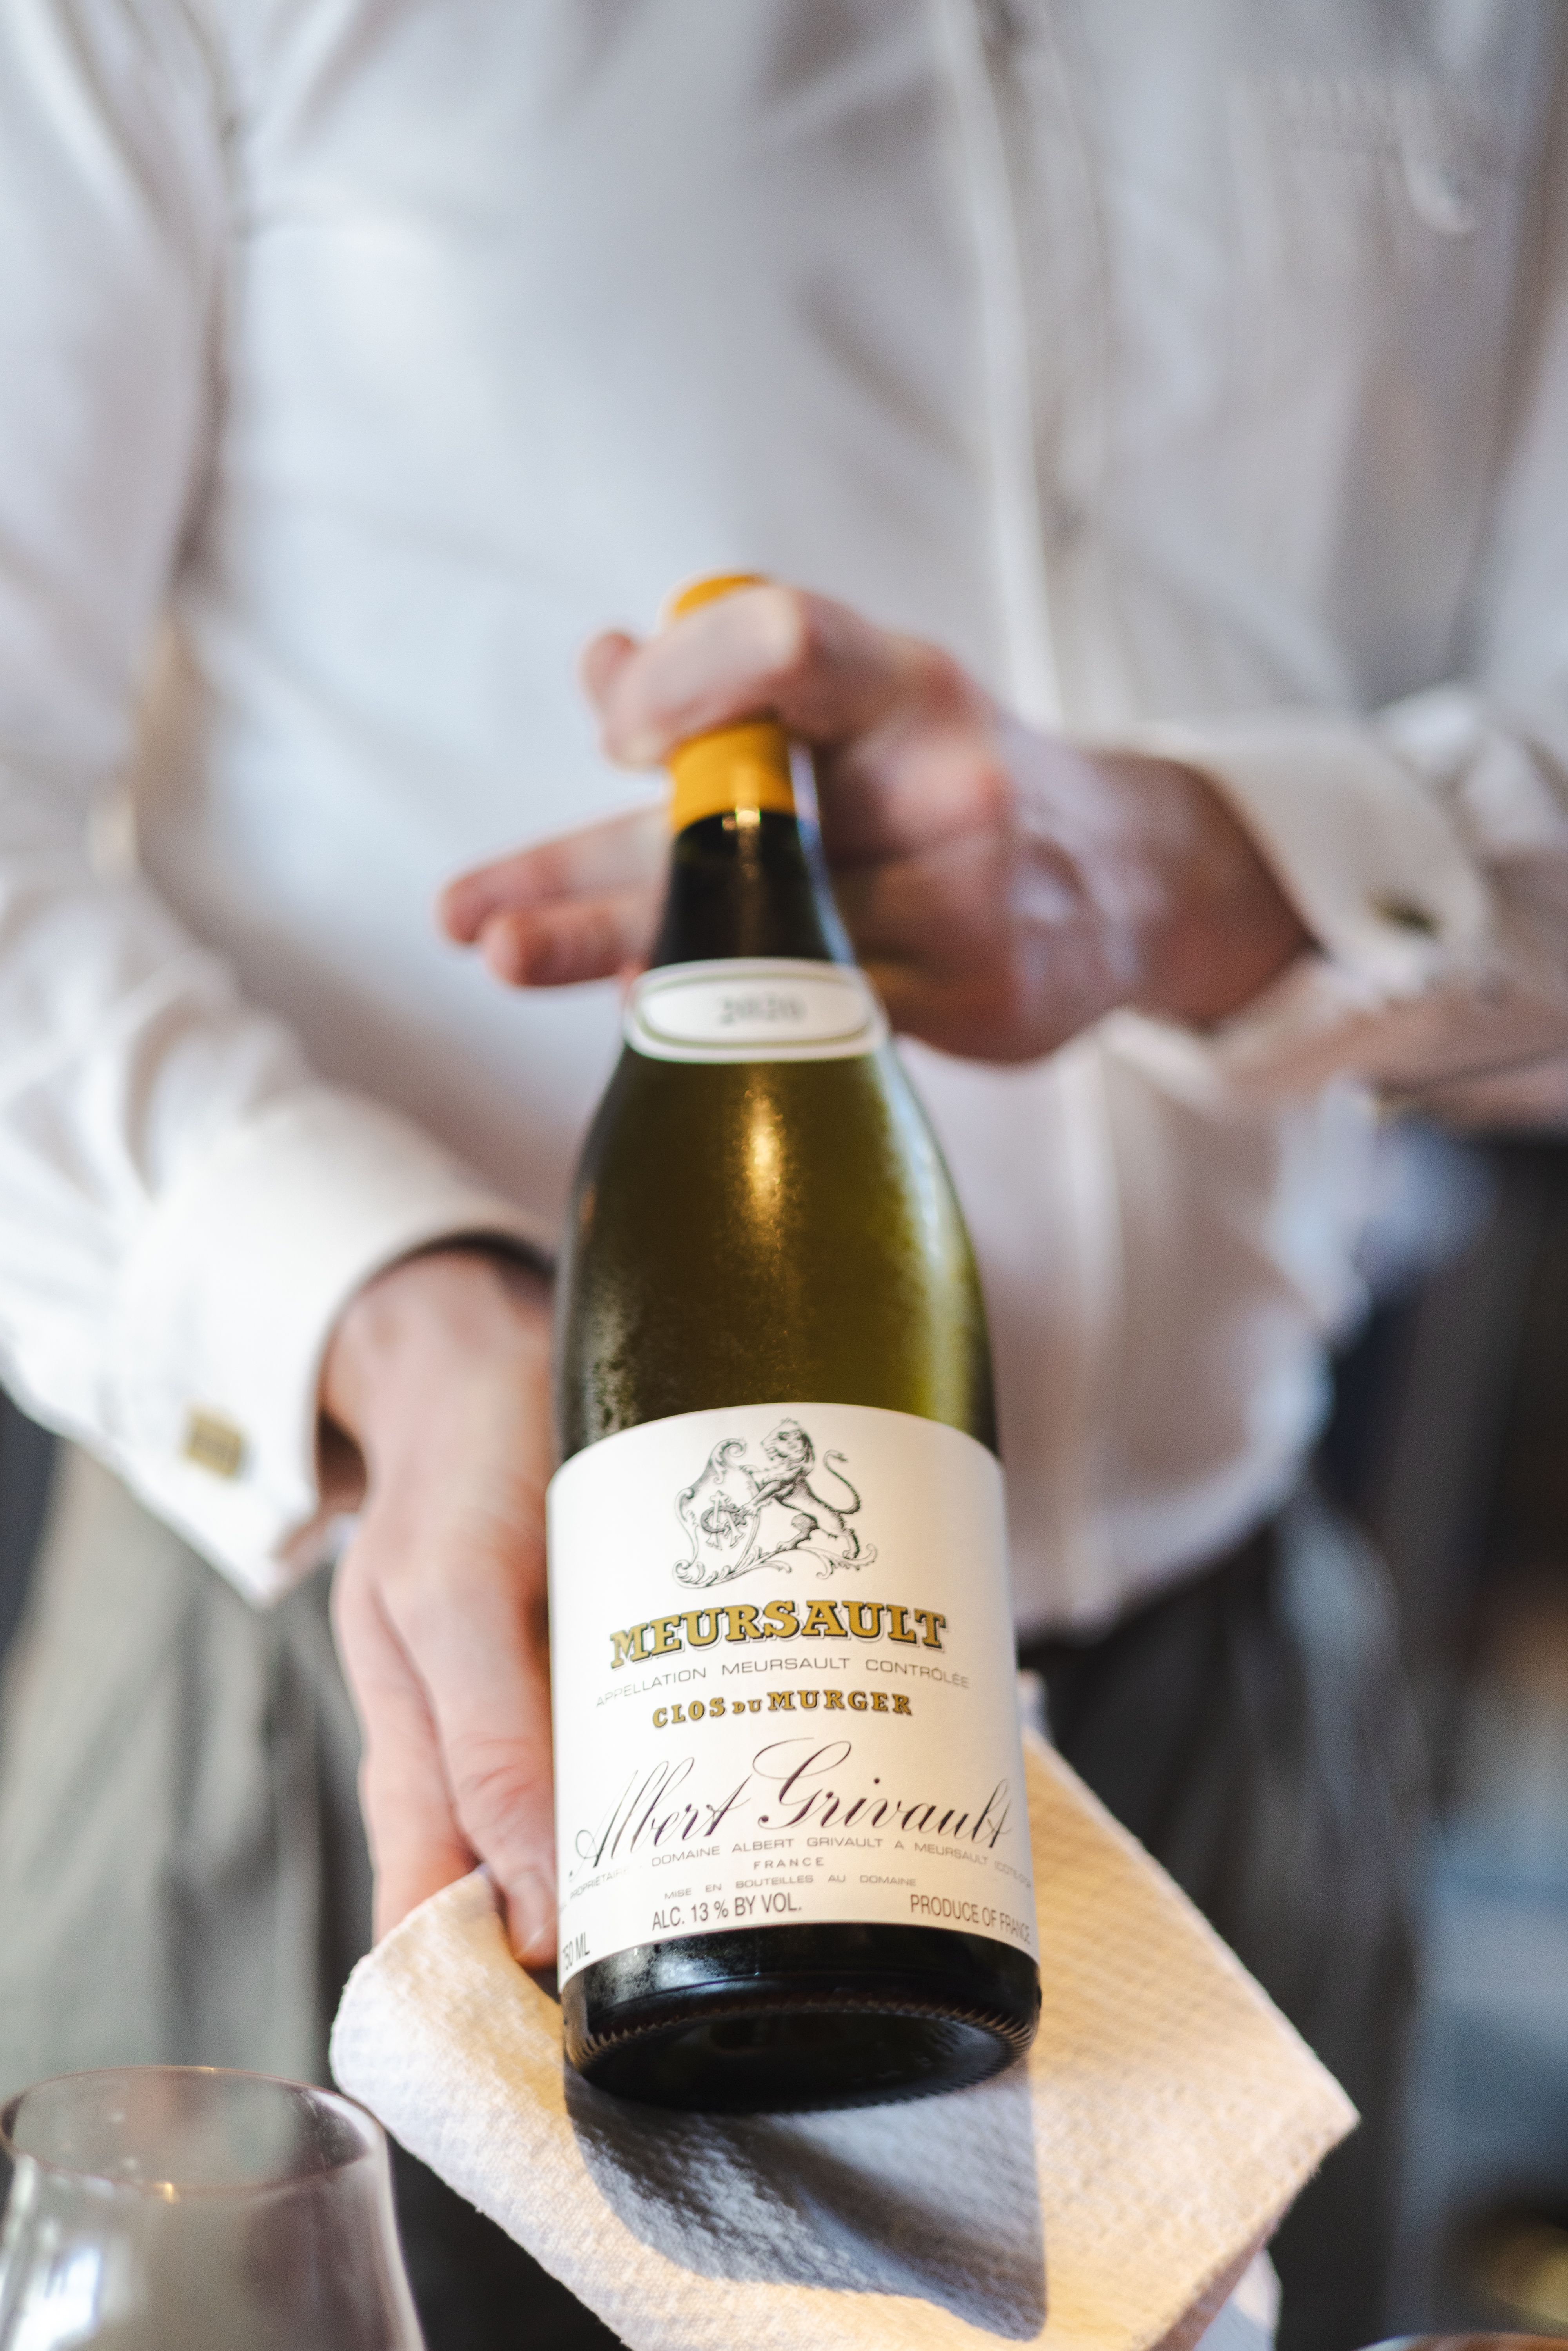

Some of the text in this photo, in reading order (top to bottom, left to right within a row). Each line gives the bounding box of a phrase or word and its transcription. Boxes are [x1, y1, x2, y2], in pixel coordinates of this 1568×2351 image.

[610, 1600, 948, 1670] MEURSAULT
[596, 1667, 706, 1707] APPELLATION
[722, 1658, 851, 1675] MEURSAULT
[653, 1689, 913, 1728] CLOS DU MURGER
[568, 1737, 1012, 1882] Albert Grivault
[652, 1846, 720, 1867] DOMAINE
[732, 1839, 795, 1853] ALBERT
[807, 1837, 883, 1848] GRIVAULT
[915, 1843, 988, 1866] MEURSAULT
[753, 1857, 825, 1870] FRANCE
[664, 1875, 916, 1900] MISE EN BOUTEILLES AU DOMAINE
[652, 1893, 802, 1932] ALC. 13 % BY VOL.
[910, 1894, 979, 1923] PRODUCE
[982, 1906, 996, 1928] OF
[575, 1931, 590, 1961] ML
